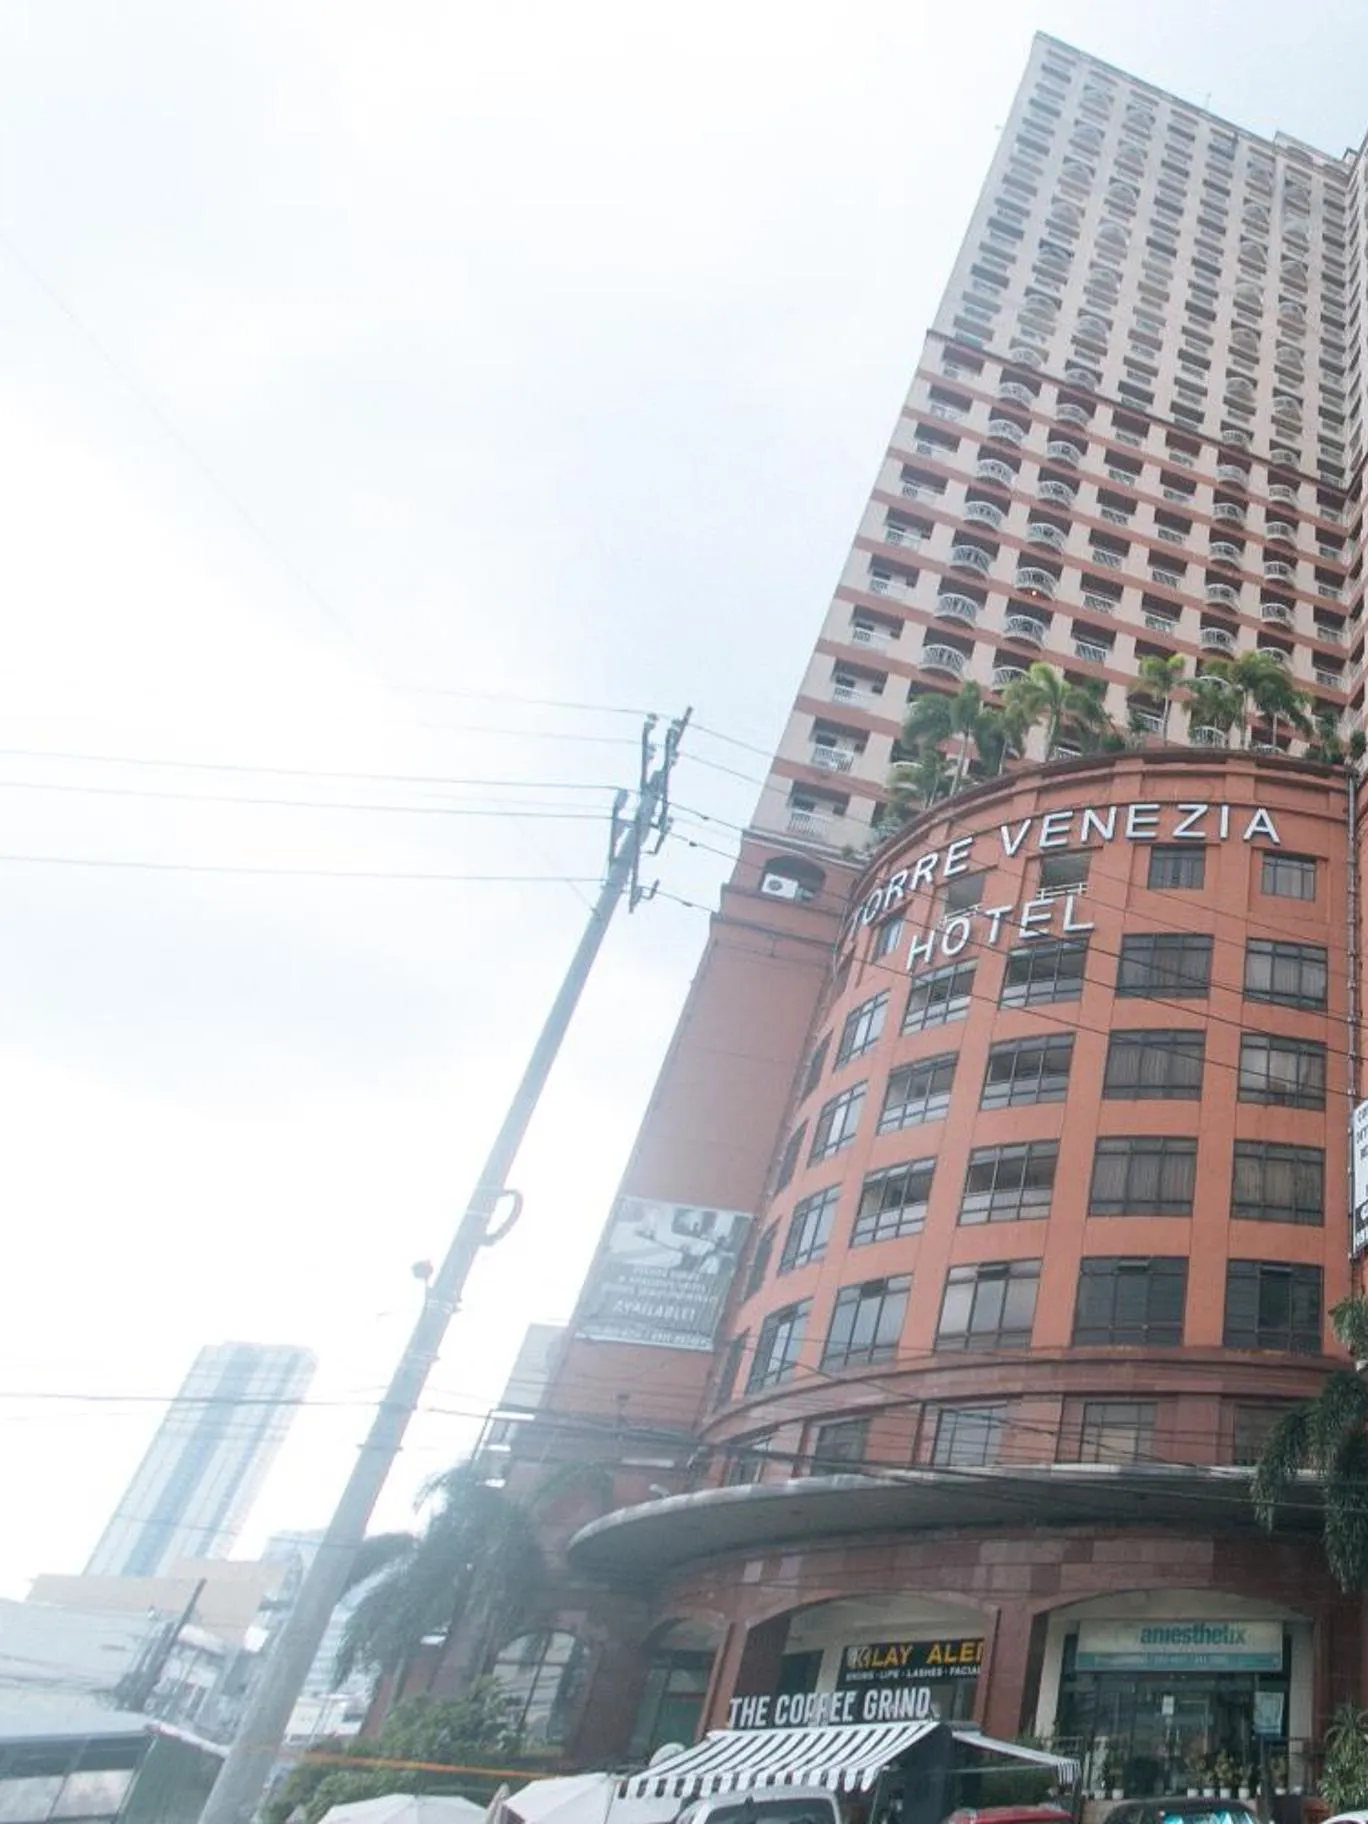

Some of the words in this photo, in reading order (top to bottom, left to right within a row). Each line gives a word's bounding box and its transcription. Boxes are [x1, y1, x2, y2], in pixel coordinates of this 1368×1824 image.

[848, 836, 973, 934] TORRE
[1001, 803, 1281, 857] VENEZIA
[905, 895, 1095, 970] HOTEL
[906, 1666, 943, 1679] LASHES
[727, 1695, 771, 1729] THE
[774, 1691, 857, 1727] COFFEE
[863, 1686, 931, 1721] GRIND
